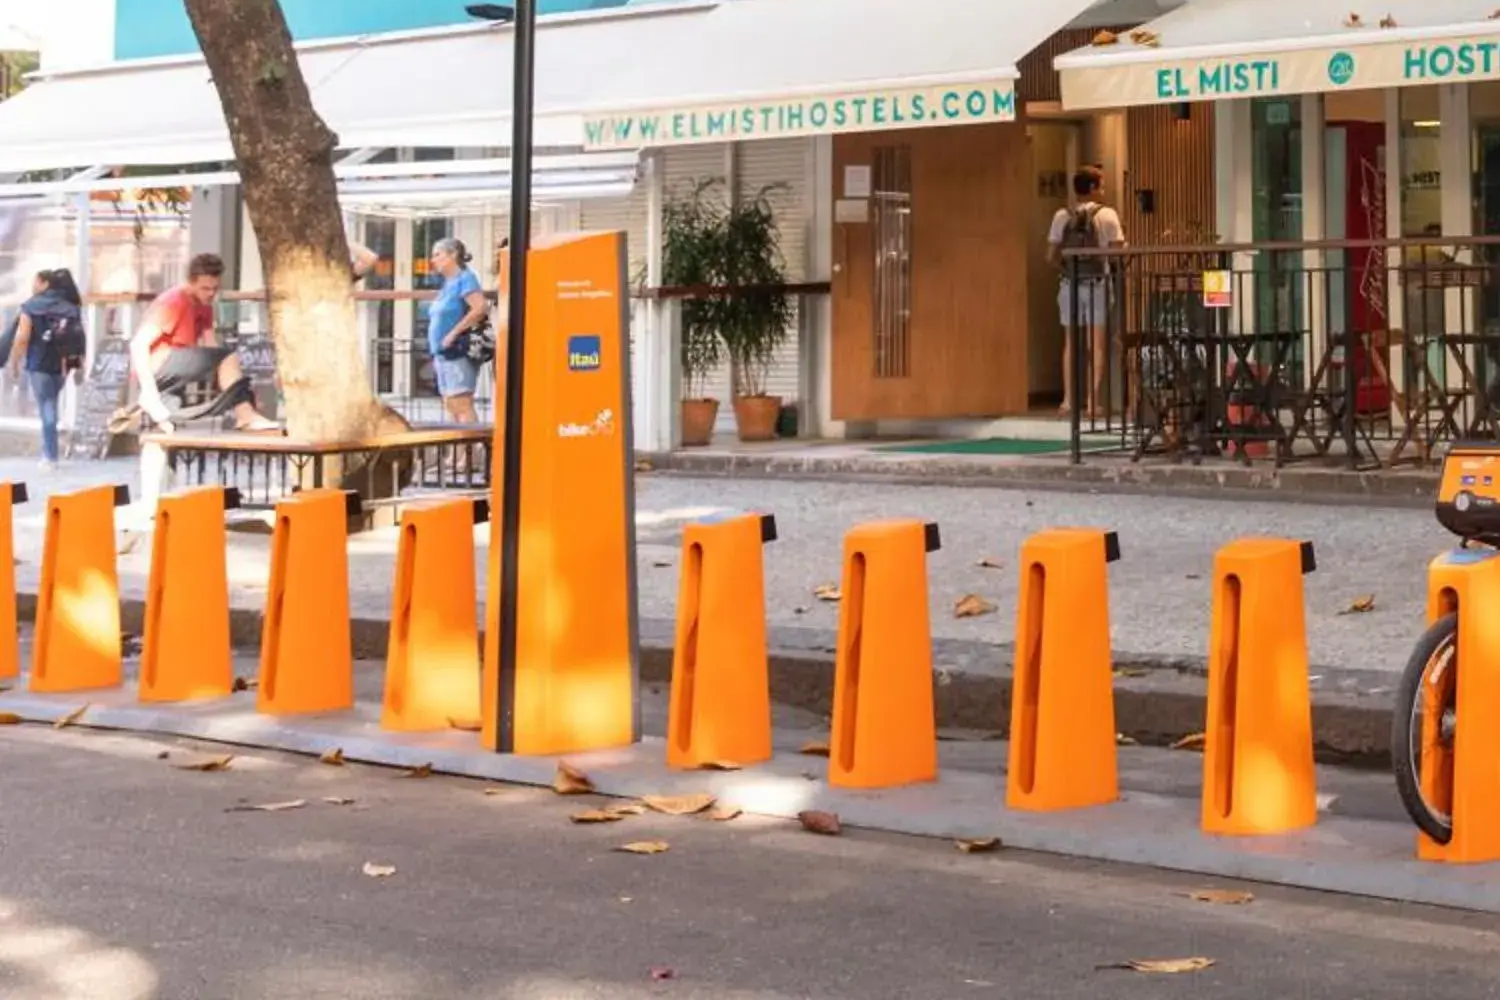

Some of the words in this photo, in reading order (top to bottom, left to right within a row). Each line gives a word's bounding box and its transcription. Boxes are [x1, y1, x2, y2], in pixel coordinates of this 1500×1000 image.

[1157, 67, 1189, 98] EL
[1199, 60, 1279, 94] MISTI
[584, 89, 1014, 144] WWW.ELMISTIHOSTELS.COM
